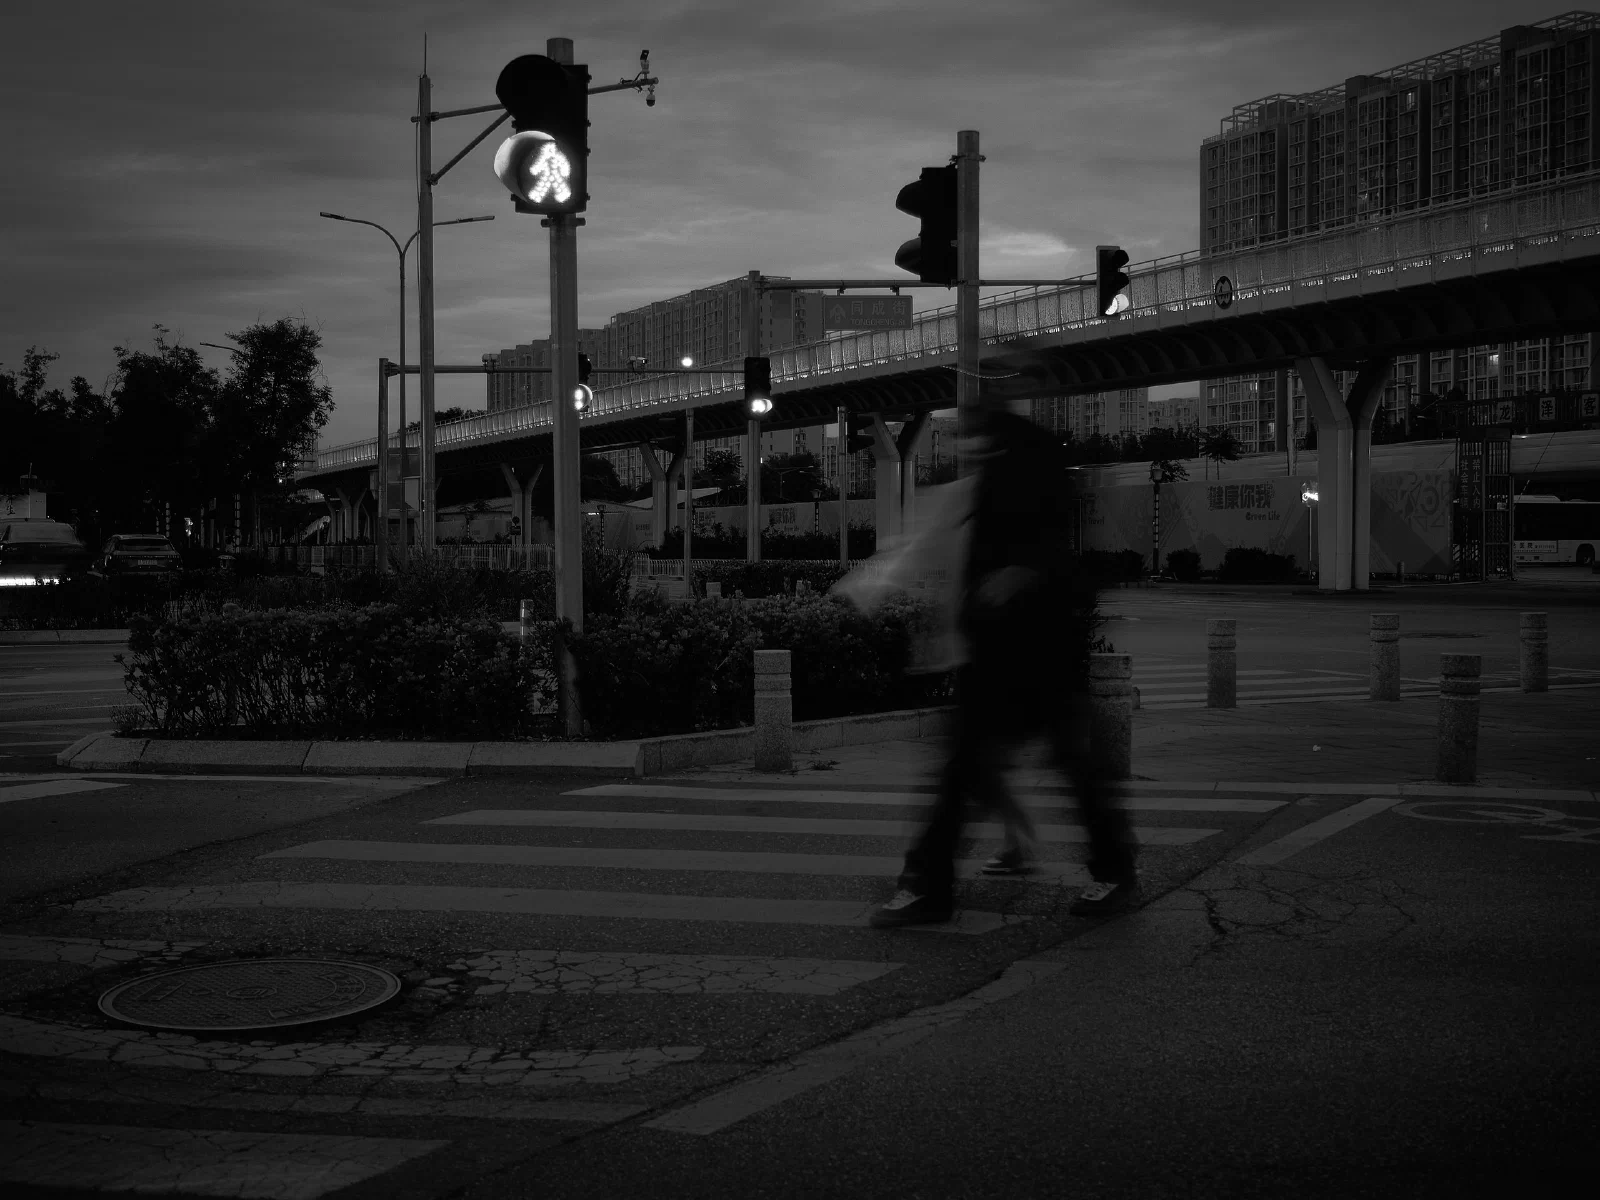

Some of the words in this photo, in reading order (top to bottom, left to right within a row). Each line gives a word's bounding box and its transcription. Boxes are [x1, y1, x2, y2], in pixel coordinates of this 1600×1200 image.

[851, 300, 907, 315] 同成街
[850, 318, 895, 326] TONGCHENG
[1472, 458, 1481, 509] 禁止入内
[1207, 483, 1272, 511] 健康你我
[1245, 511, 1267, 521] Green
[1268, 510, 1281, 521] Life
